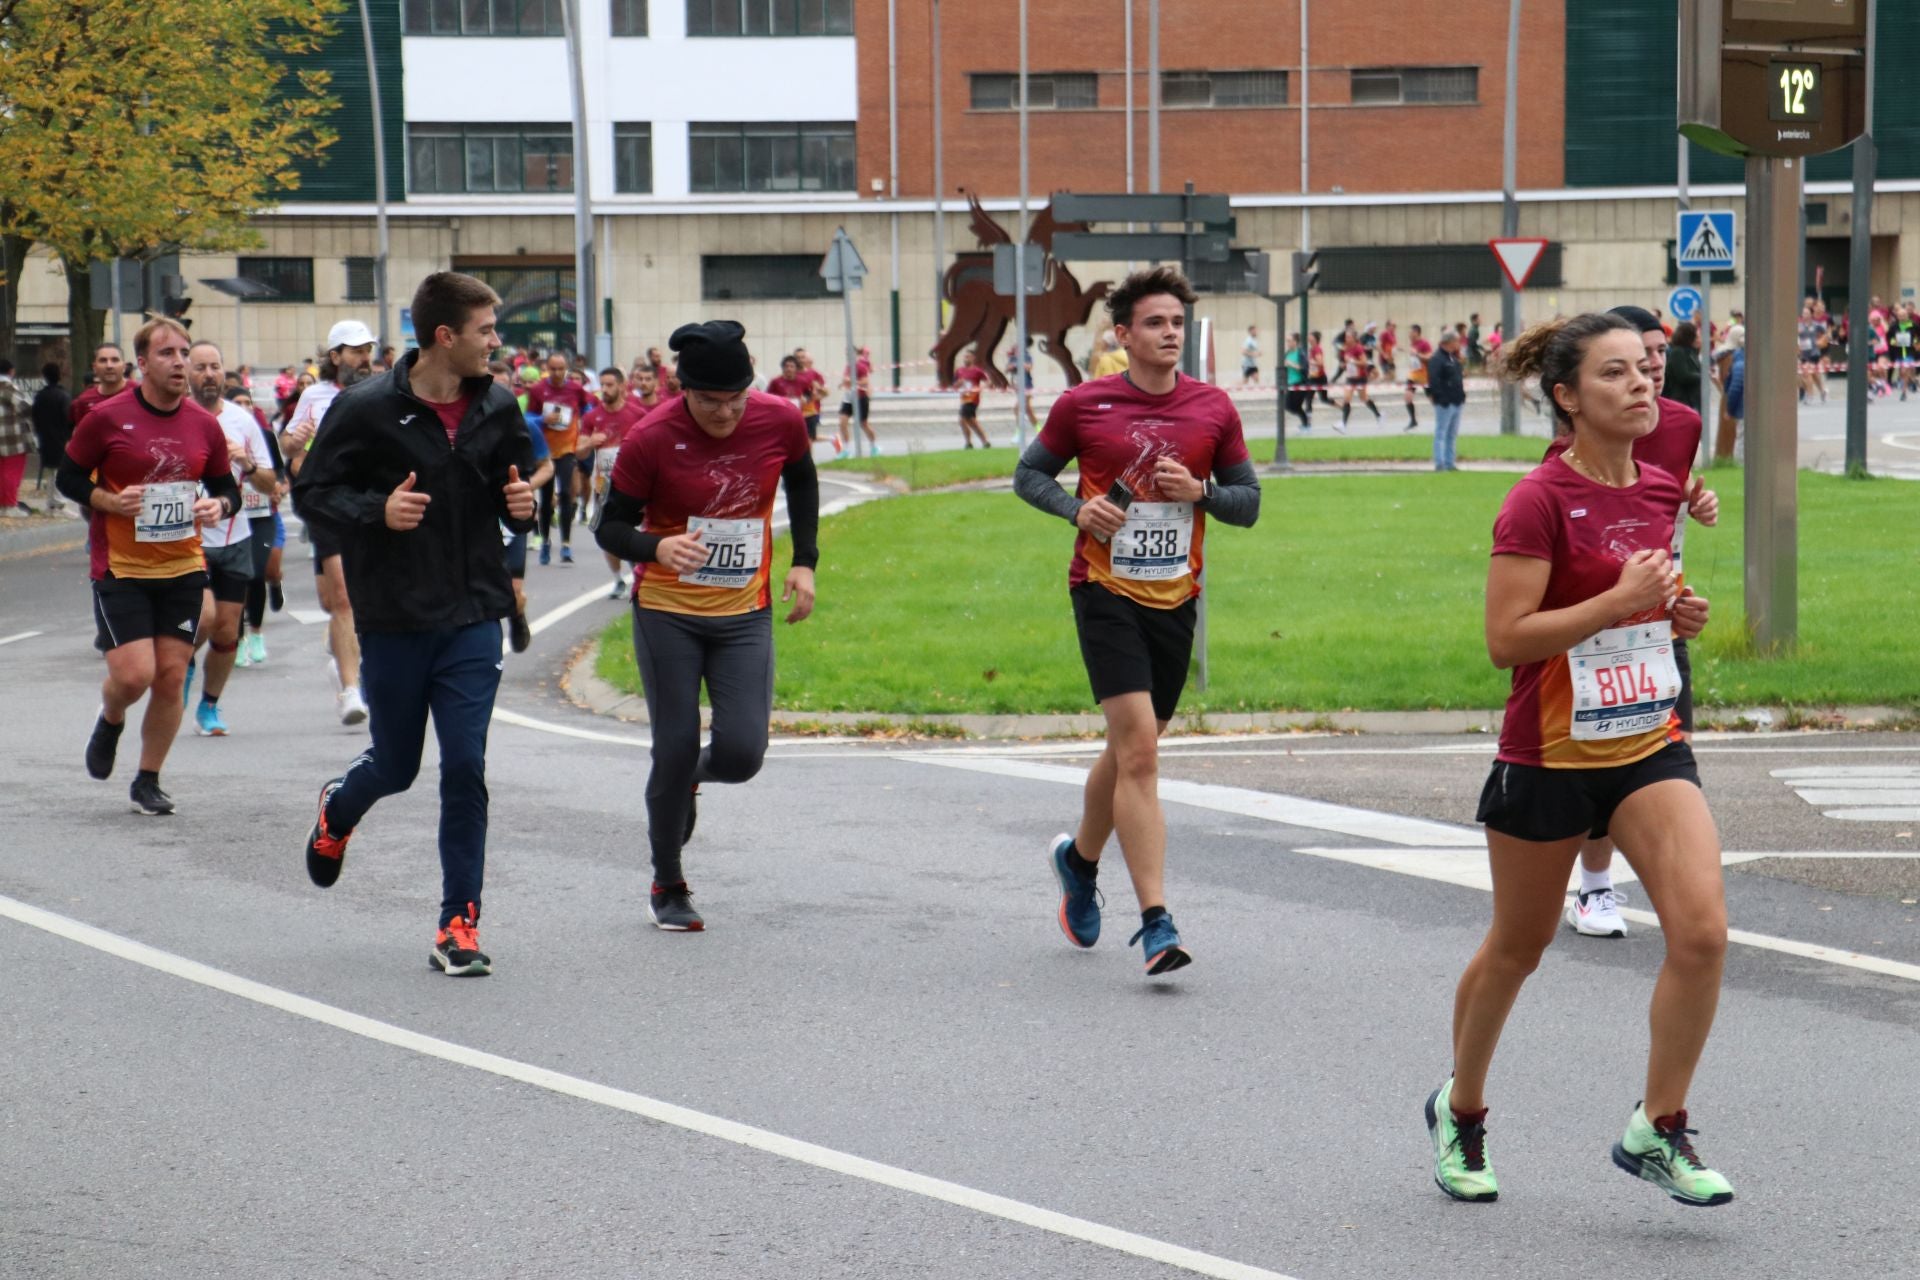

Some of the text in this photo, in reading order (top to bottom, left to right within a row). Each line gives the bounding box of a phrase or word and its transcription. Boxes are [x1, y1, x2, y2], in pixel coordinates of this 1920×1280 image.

[152, 502, 184, 525] 720
[706, 543, 746, 567] 705
[1133, 529, 1177, 557] 338
[1595, 662, 1658, 706] 804
[1616, 713, 1662, 728] HYUNDAI
